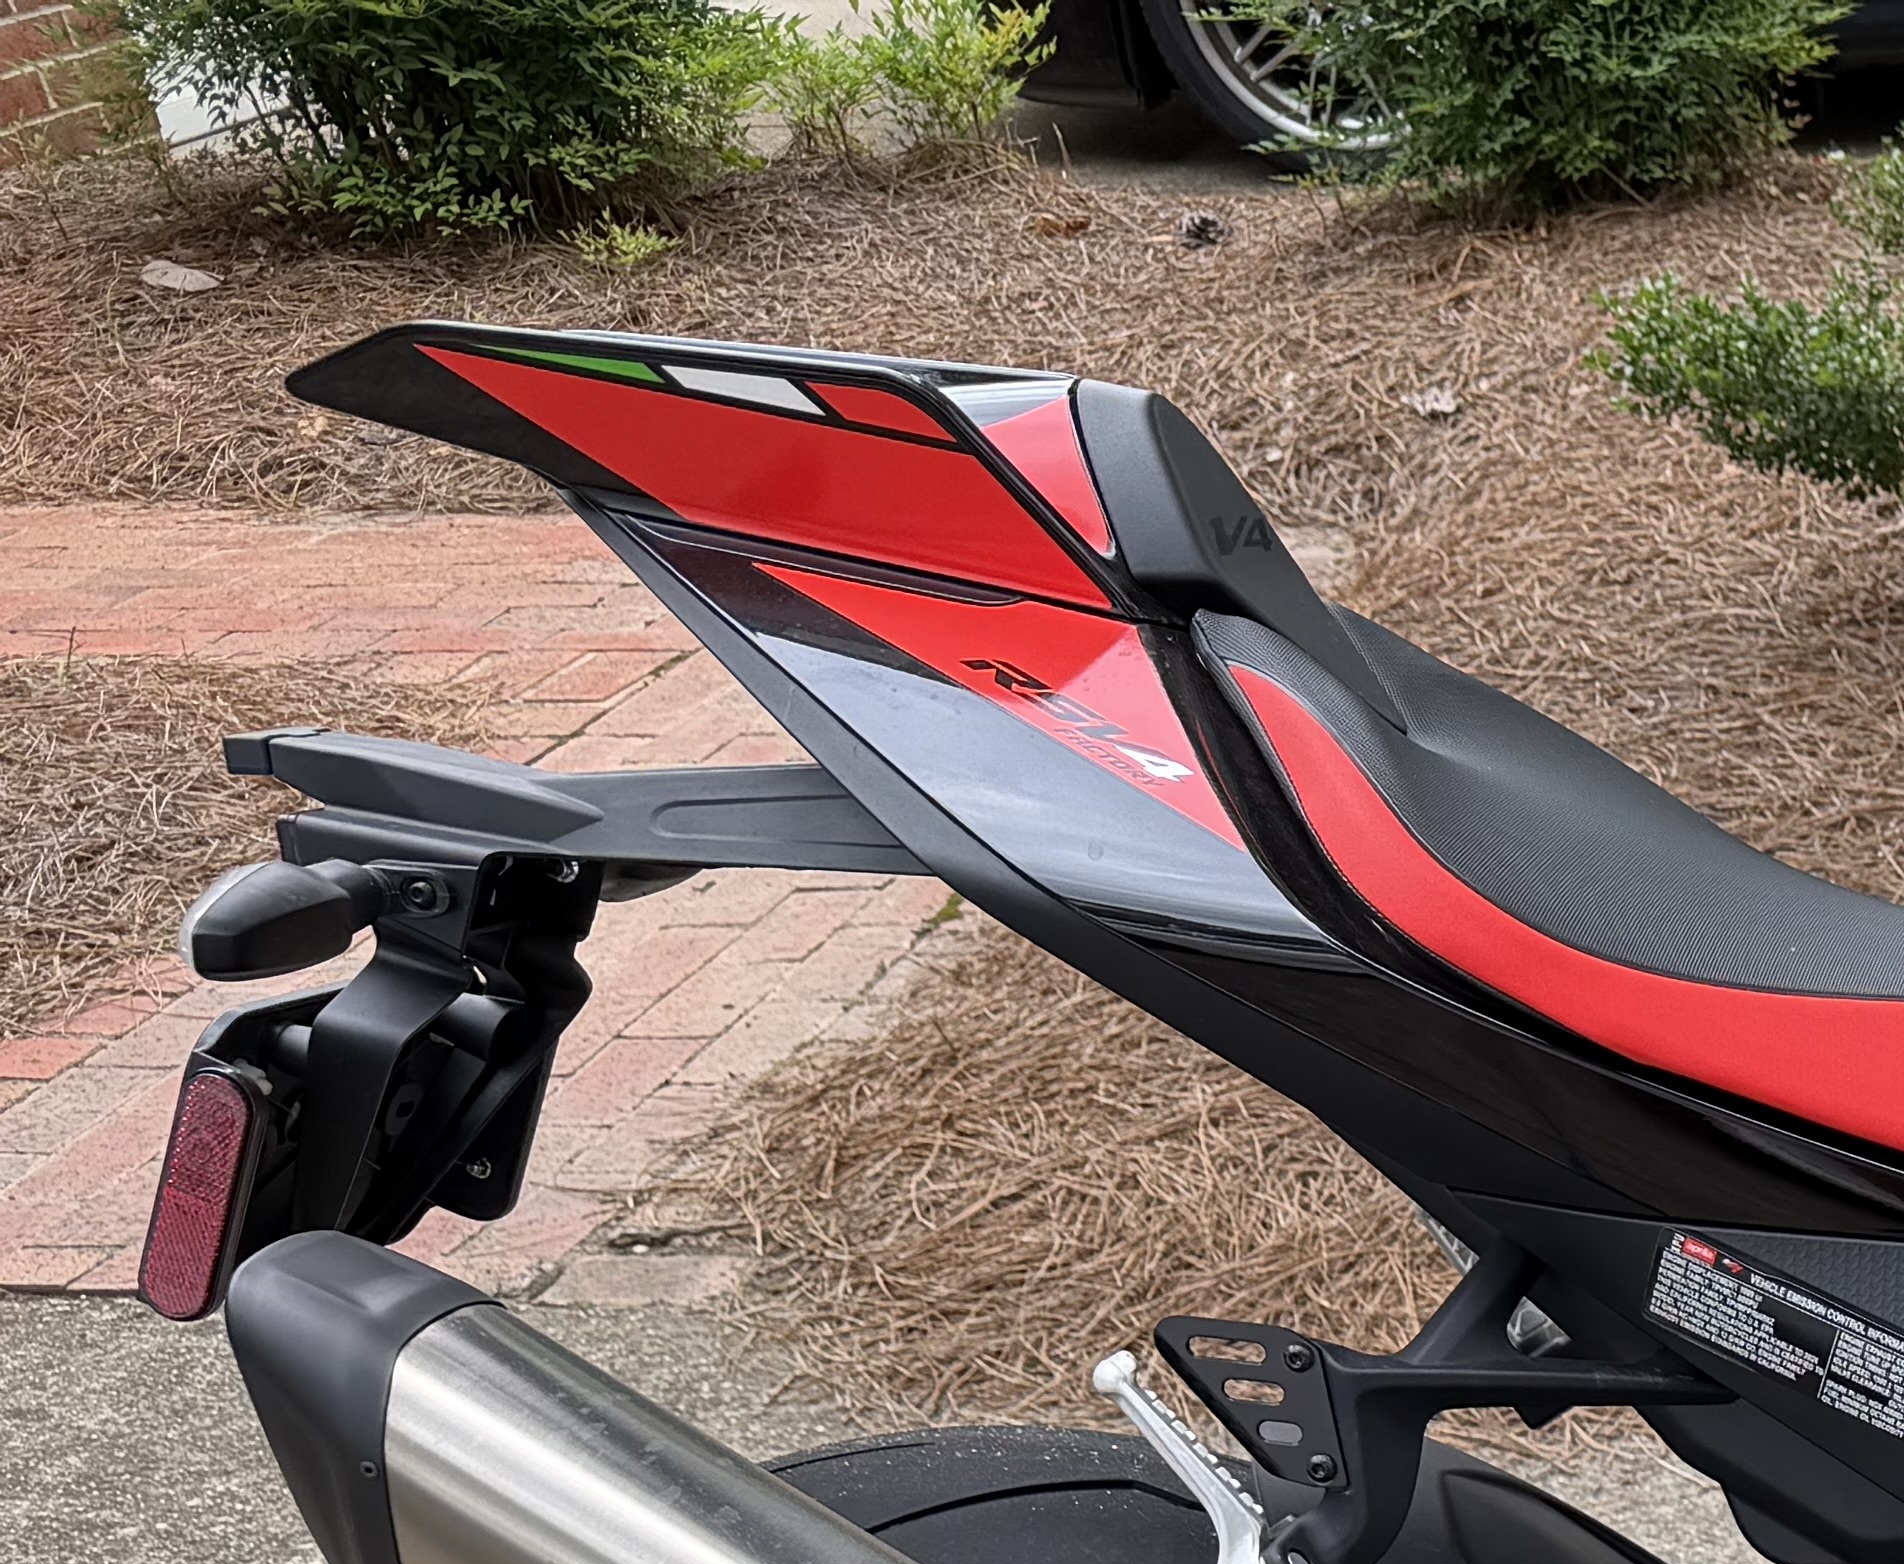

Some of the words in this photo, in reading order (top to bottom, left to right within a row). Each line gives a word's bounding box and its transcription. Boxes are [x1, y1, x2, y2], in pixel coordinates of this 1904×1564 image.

[1209, 516, 1273, 556] V4
[959, 659, 1195, 783] RSV4
[1054, 728, 1164, 786] FACTORY
[1750, 1273, 1786, 1296] VEHICLE
[1826, 1309, 1867, 1336] CONTROL
